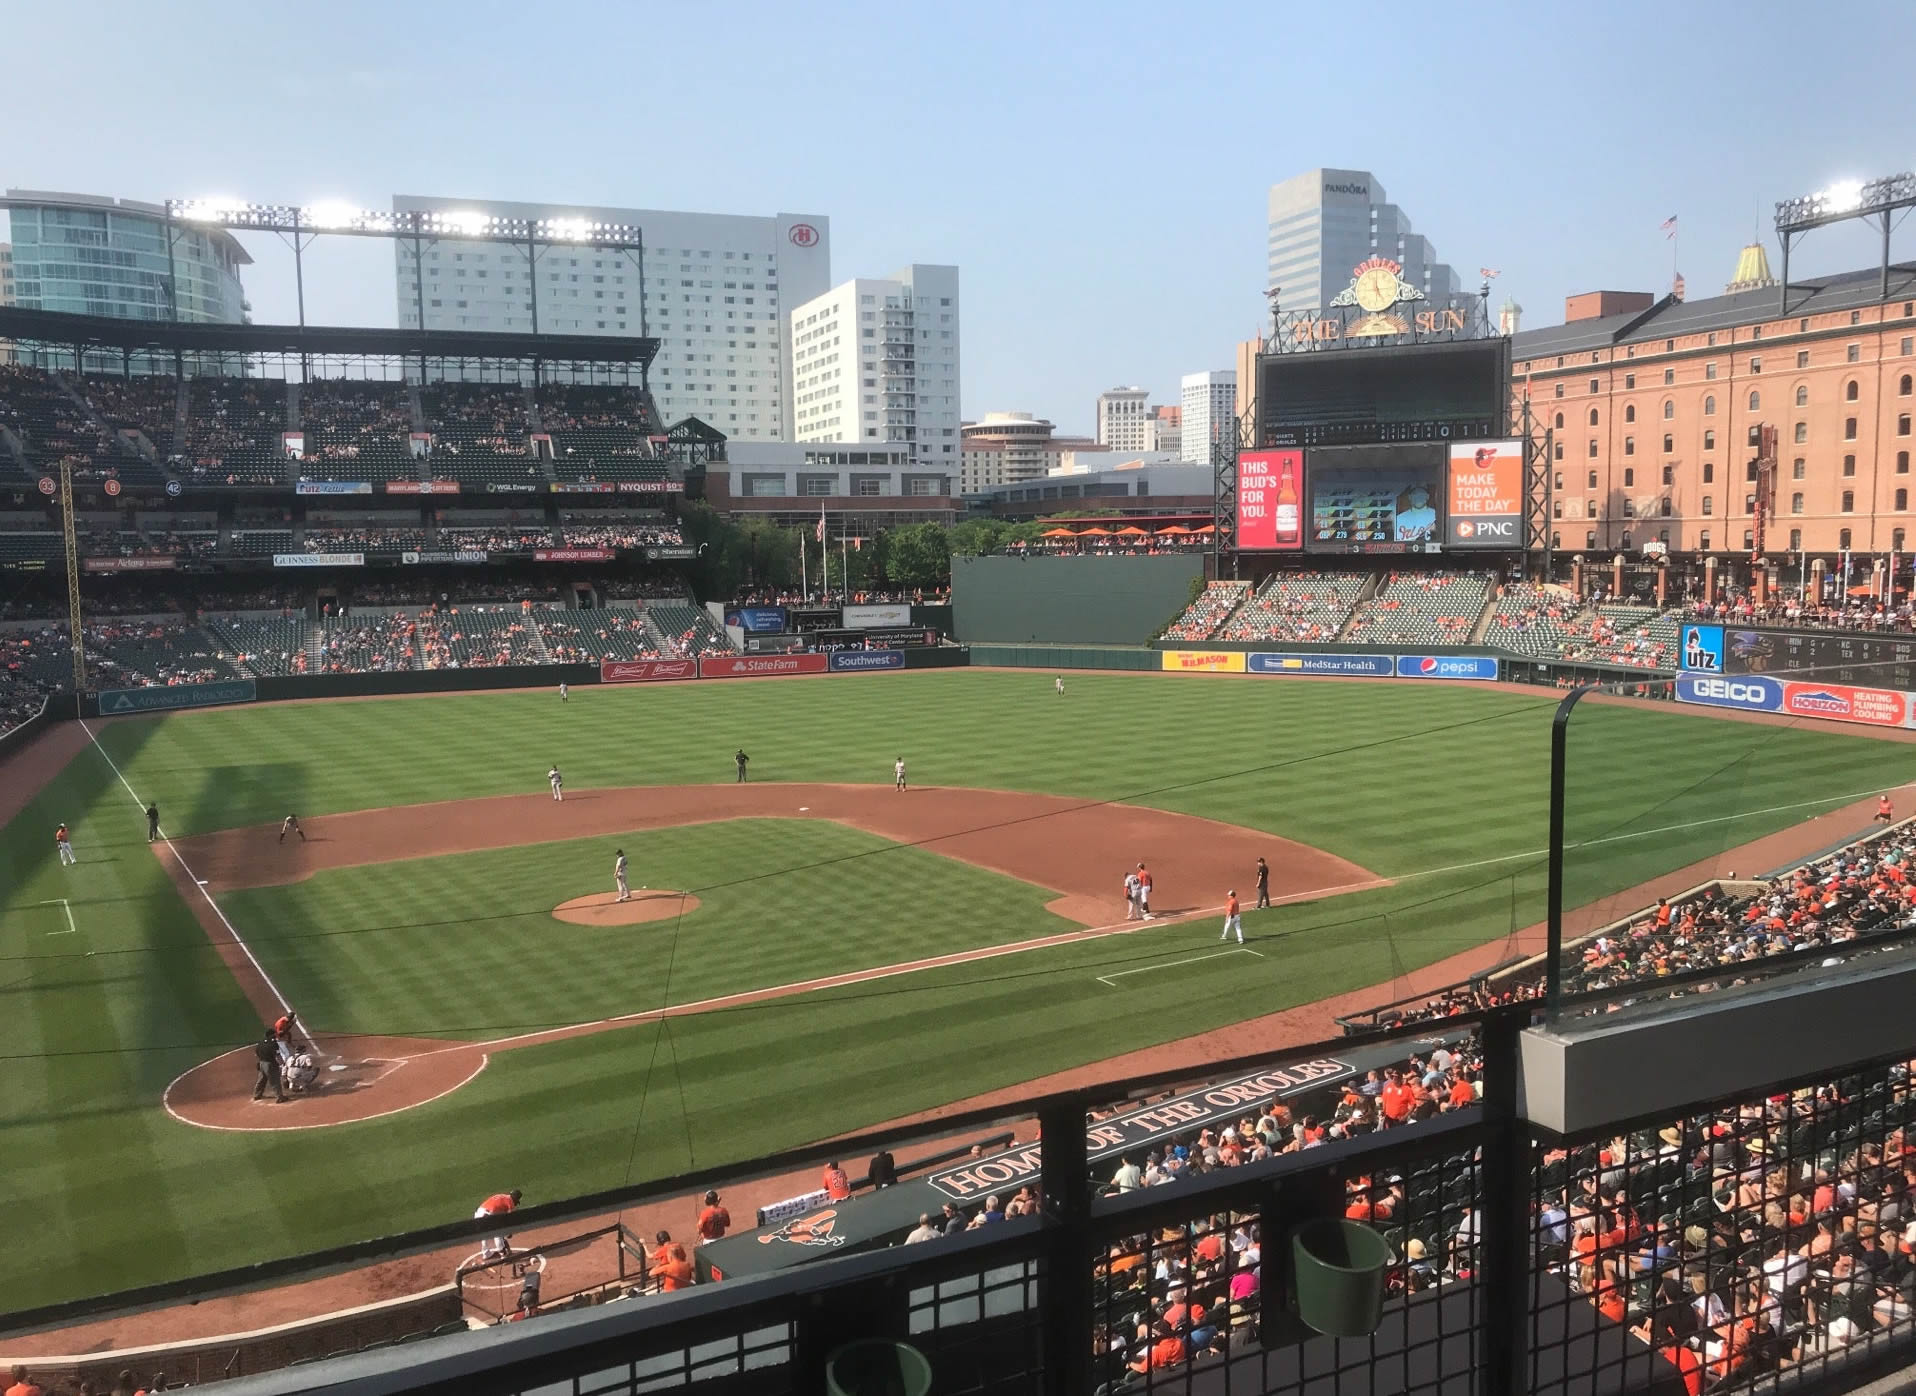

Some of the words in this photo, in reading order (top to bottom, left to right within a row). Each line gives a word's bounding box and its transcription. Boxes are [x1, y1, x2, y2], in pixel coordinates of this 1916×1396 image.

[1353, 258, 1401, 277] ORIOLES
[1295, 320, 1340, 341] THE
[1415, 309, 1465, 333] SUN
[1440, 426, 1449, 437] 0
[1241, 462, 1268, 474] THIS
[1241, 476, 1277, 489] BUD'S
[1456, 473, 1496, 486] MAKE
[43, 481, 54, 491] 33
[168, 483, 179, 493] 42
[620, 483, 662, 492] NYQUIST
[1241, 491, 1264, 503] FOR
[1456, 486, 1498, 499] TODAY
[1241, 505, 1268, 518] YOU.
[1456, 500, 1482, 512] THE
[1485, 499, 1511, 512] DAY
[1476, 522, 1513, 535] PNC
[275, 555, 318, 564] GUINNESS
[454, 551, 487, 561] UNION
[838, 656, 890, 666] Southwest
[1303, 661, 1342, 670] MedStar
[1343, 661, 1376, 671] Health
[1440, 661, 1477, 675] pepsi
[1693, 680, 1766, 703] GEICO
[1853, 692, 1892, 703] HEATING
[1793, 697, 1849, 712] HORIZON
[1853, 701, 1899, 713] PLUMBING
[1853, 710, 1892, 721] COOLING
[938, 1146, 1041, 1194] HOM
[1121, 1100, 1212, 1132] THE
[1204, 1058, 1344, 1107] ORIOLES
